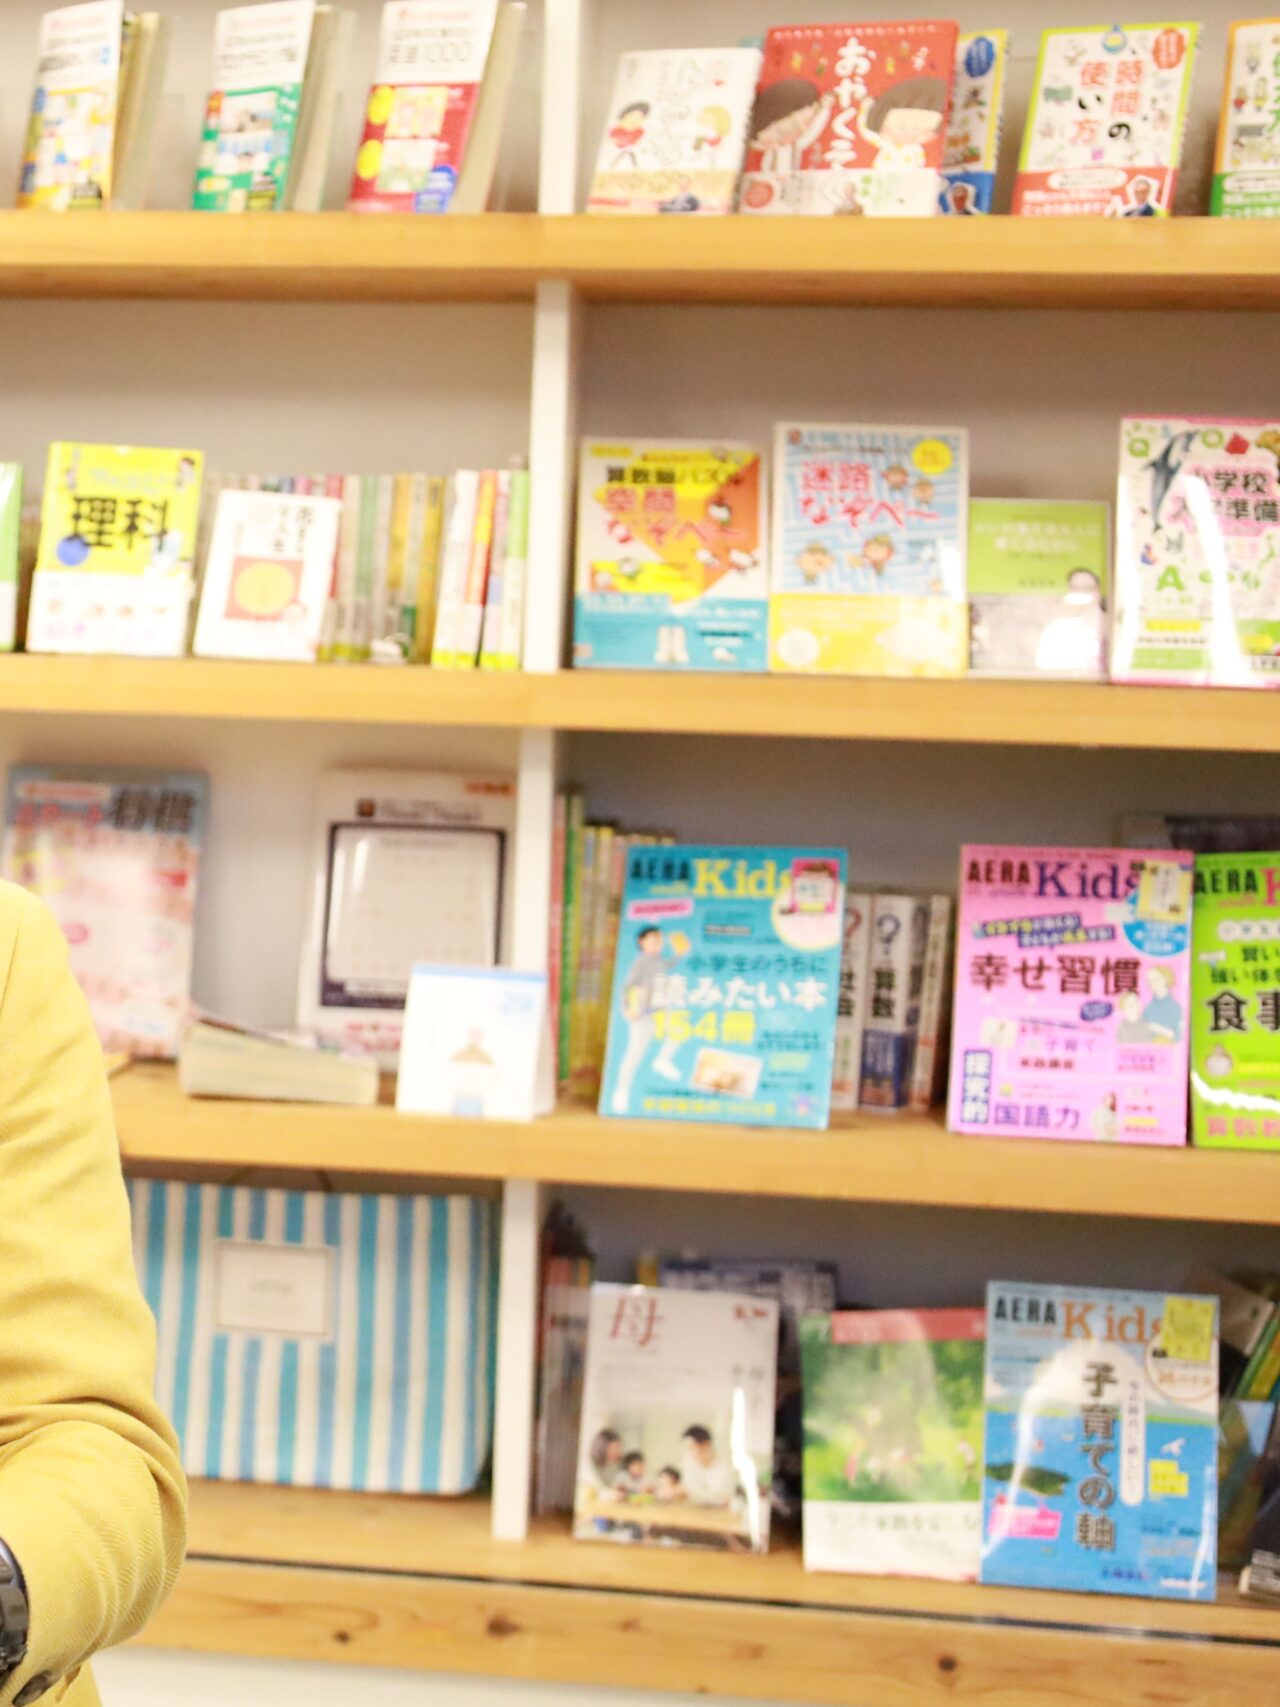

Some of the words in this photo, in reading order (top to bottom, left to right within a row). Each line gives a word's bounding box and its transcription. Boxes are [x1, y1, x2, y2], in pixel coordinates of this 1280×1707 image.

[1070, 61, 1109, 145] 使い方
[1108, 60, 1144, 142] 時間の
[799, 461, 872, 491] 迷路
[71, 496, 169, 552] 理科
[1169, 496, 1280, 523] 入準備
[631, 859, 690, 881] AERA
[967, 859, 1031, 884] AERA
[1194, 868, 1259, 895] AERA
[687, 953, 829, 974] 小学生のうちに
[969, 954, 1141, 995] 幸せ習慣
[650, 974, 829, 1012] 読みたい本
[652, 1009, 756, 1044] 154冊
[993, 1105, 1081, 1129] 国語力
[994, 1296, 1057, 1324] AERA
[1075, 1361, 1119, 1552] 子育ての軸
